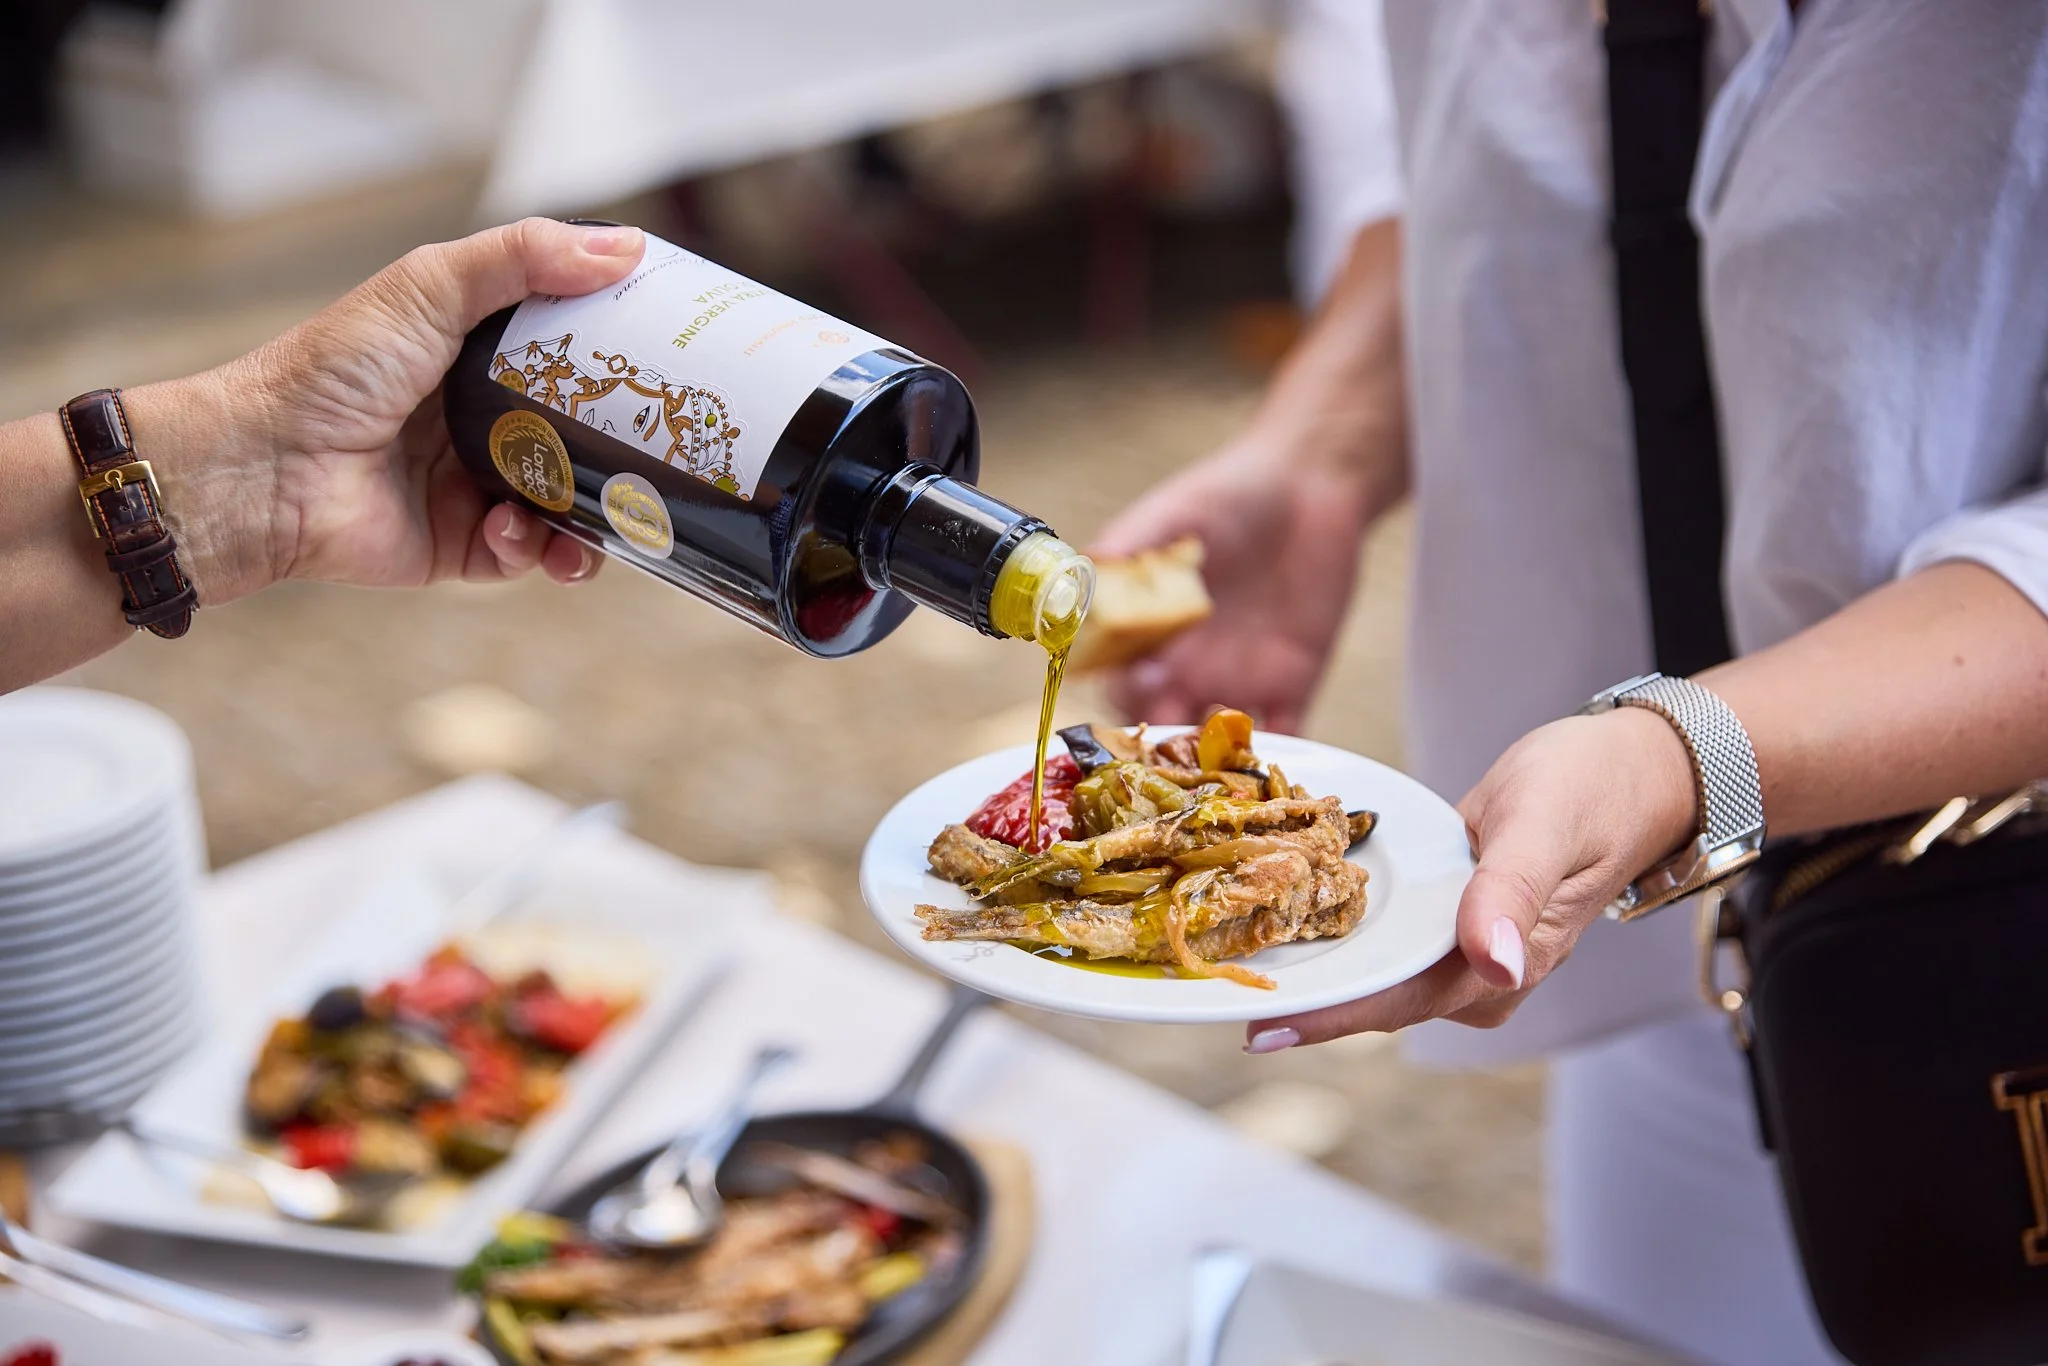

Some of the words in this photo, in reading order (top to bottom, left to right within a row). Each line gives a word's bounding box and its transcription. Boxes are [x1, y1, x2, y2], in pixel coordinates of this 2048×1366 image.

[671, 299, 736, 349] VERGINE
[523, 416, 547, 434] LONDON
[534, 442, 549, 500] London
